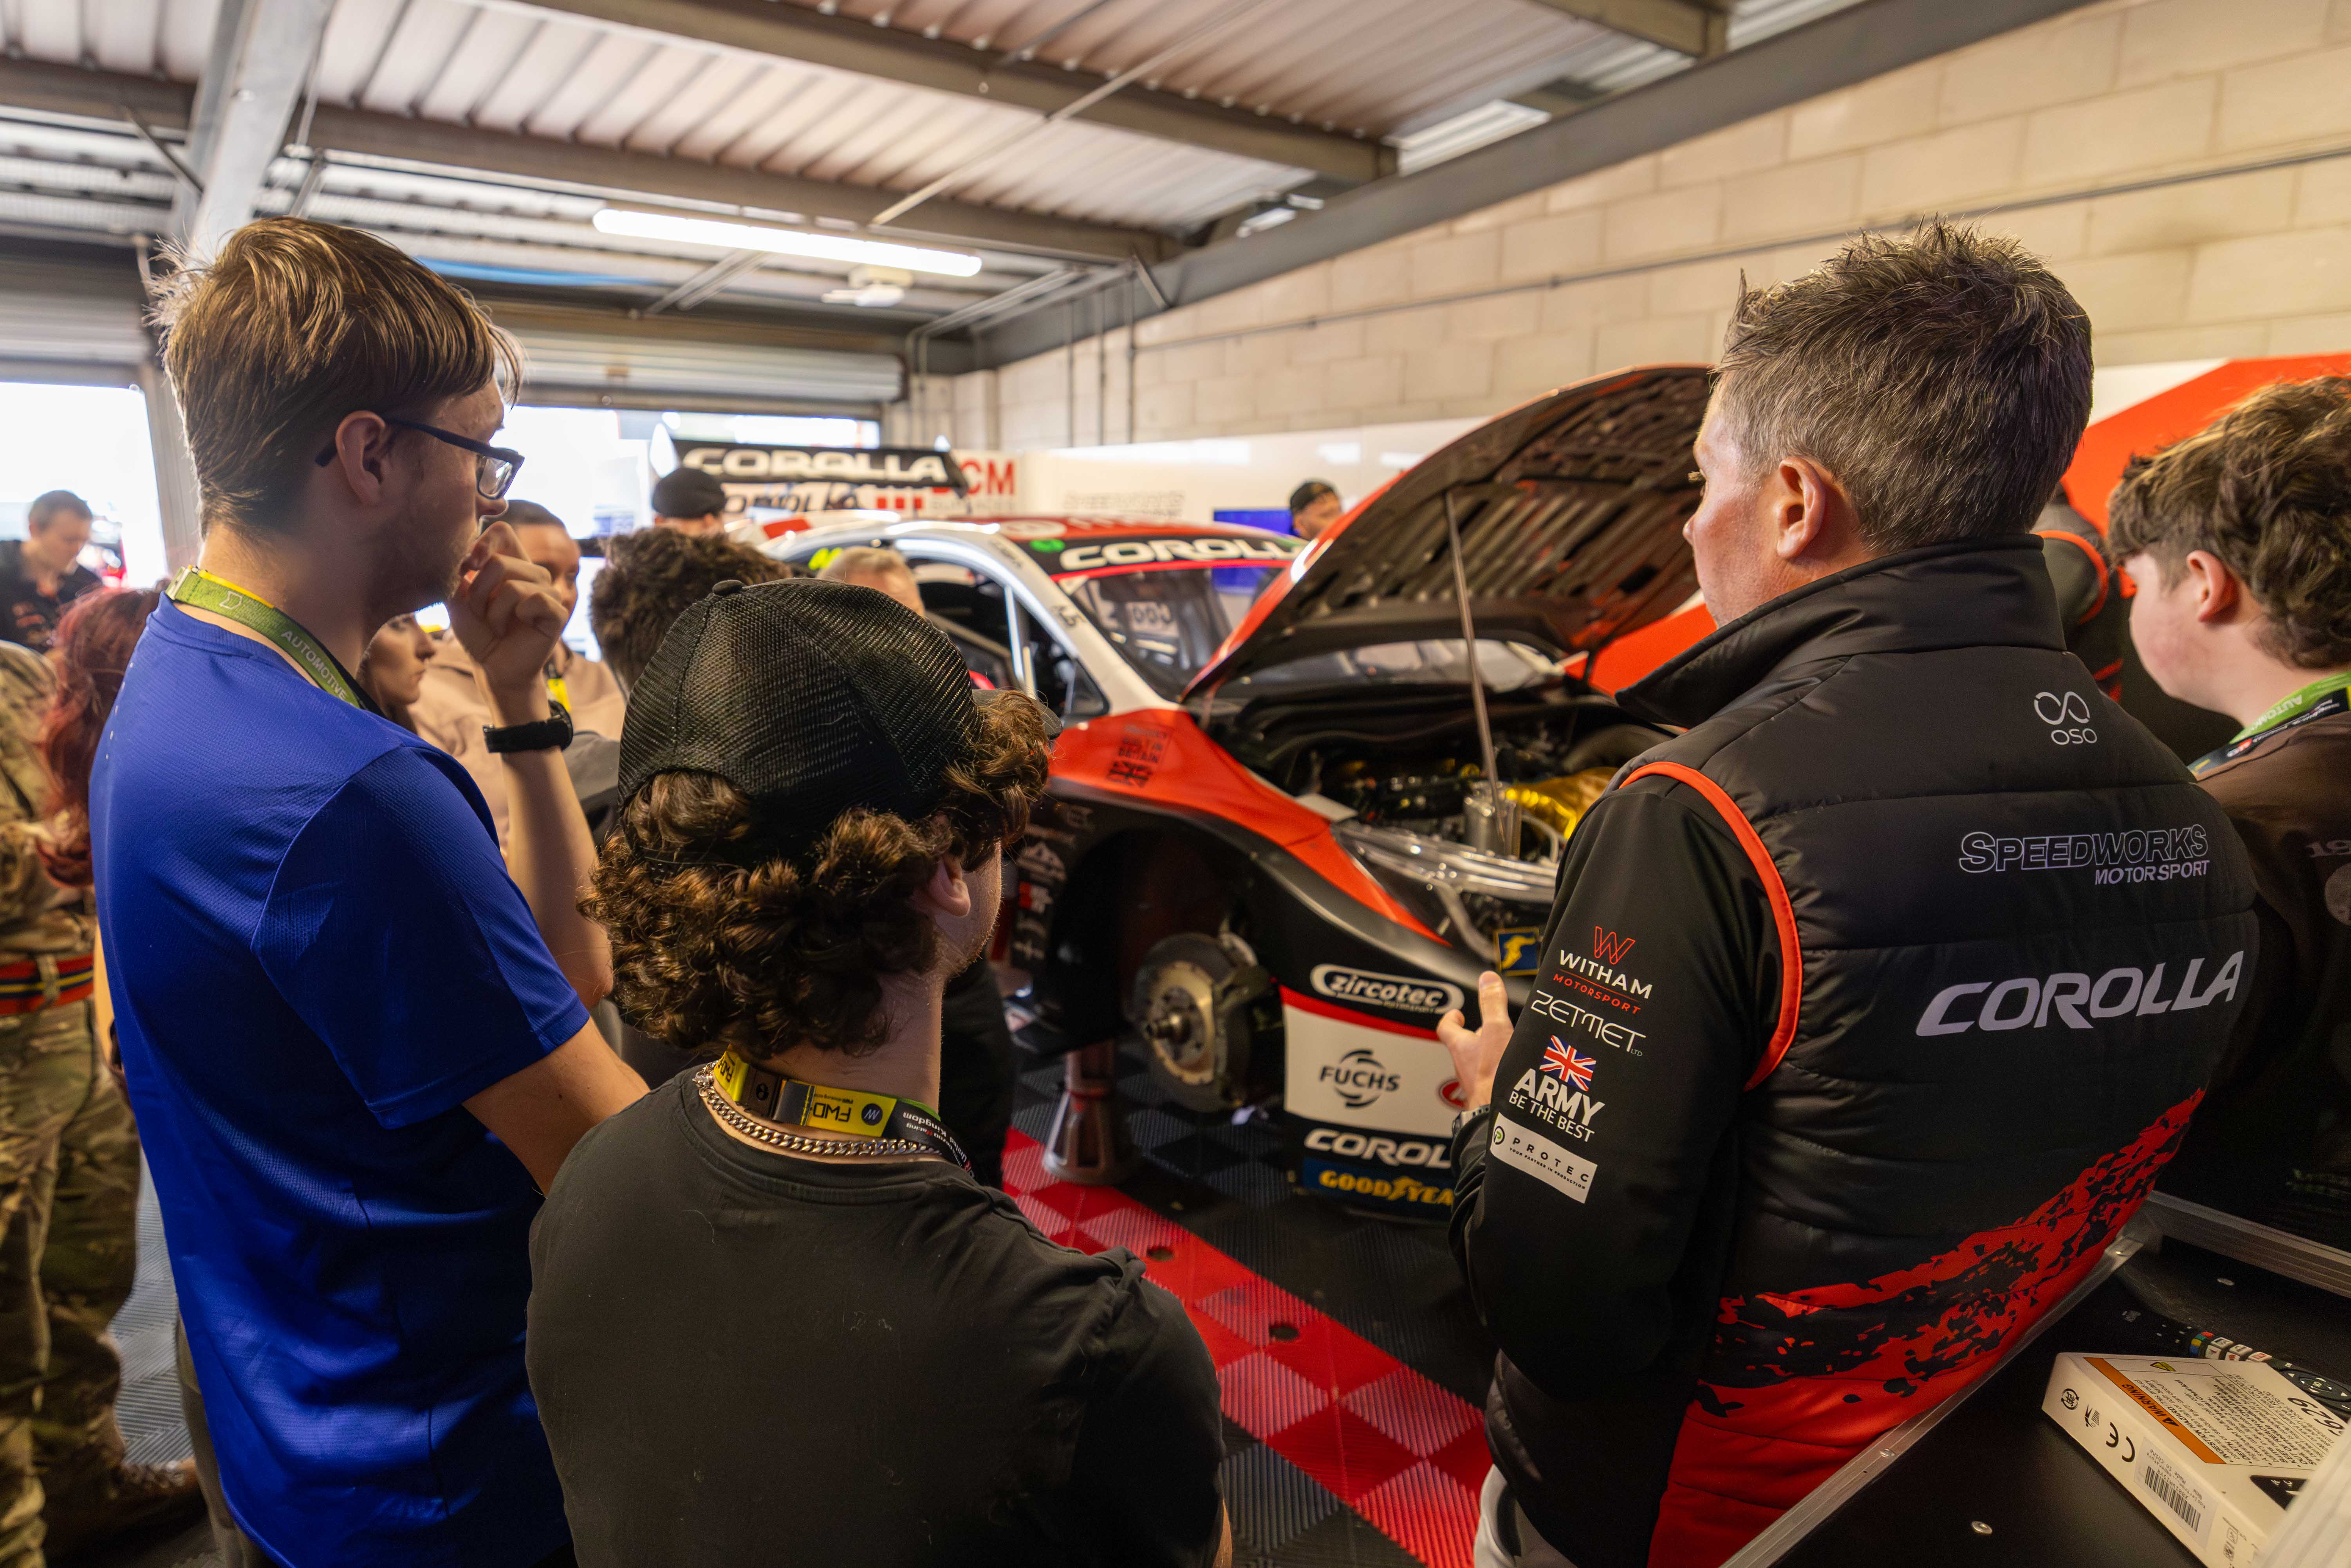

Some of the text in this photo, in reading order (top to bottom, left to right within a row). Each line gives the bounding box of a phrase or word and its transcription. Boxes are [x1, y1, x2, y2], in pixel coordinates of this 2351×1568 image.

[682, 447, 948, 483] COROLLA
[1059, 539, 1302, 571] COROLL
[281, 630, 347, 699] AUTOMOTIVE
[2051, 728, 2097, 745] OSO
[1959, 824, 2208, 873] SPEEDWORKS
[2095, 860, 2210, 886] MOTORSPORT
[1559, 949, 1653, 999] WITHAM
[1329, 973, 1446, 1008] zircotec
[1553, 973, 1641, 1014] MOTORSPORT
[1916, 950, 2244, 1037] COROLLA
[1531, 989, 1647, 1052] ZETMET
[1631, 1048, 1643, 1057] LTD
[1318, 1066, 1401, 1092] FUCHS
[1513, 1068, 1605, 1126] ARMY
[903, 1111, 947, 1137] Kingdom
[1509, 1090, 1595, 1142] BE THE BEST
[1304, 1128, 1452, 1169] COROL
[1513, 1137, 1589, 1183] PROTEC
[1509, 1147, 1523, 1157] YOUR
[1524, 1154, 1547, 1168] PARTNER
[1554, 1170, 1586, 1190] PRODUCTION
[1318, 1169, 1454, 1206] GOODYEA
[2143, 1380, 2164, 1393] battery
[2173, 1379, 2205, 1400] Chemical
[2183, 1392, 2198, 1401] coin
[2122, 1384, 2167, 1417] WARNING
[2181, 1404, 2199, 1416] injury
[2200, 1401, 2227, 1418] Internal
[2213, 1392, 2250, 1416] CHILDREN
[2164, 1405, 2196, 1428] HAZARD:
[2190, 1419, 2210, 1433] button
[2196, 1417, 2221, 1434] serious
[2211, 1416, 2234, 1430] button
[2234, 1415, 2252, 1425] used
[2236, 1405, 2266, 1423] medical
[2287, 1397, 2346, 1436] 629
[2229, 1431, 2265, 1456] swallowed
[2249, 1427, 2265, 1436] and
[2253, 1423, 2281, 1442] REACH
[2261, 1424, 2300, 1451] immediate
[2263, 1437, 2279, 1447] new
[2149, 1448, 2164, 1464] China
[2192, 1429, 2232, 1459] INGESTION
[2213, 1439, 2241, 1459] contains
[2223, 1441, 2251, 1460] DEATH
[2254, 1445, 2281, 1462] battery
[2264, 1447, 2289, 1463] Burns
[2274, 1448, 2299, 1463] KEEP
[2288, 1452, 2309, 1464] OUT
